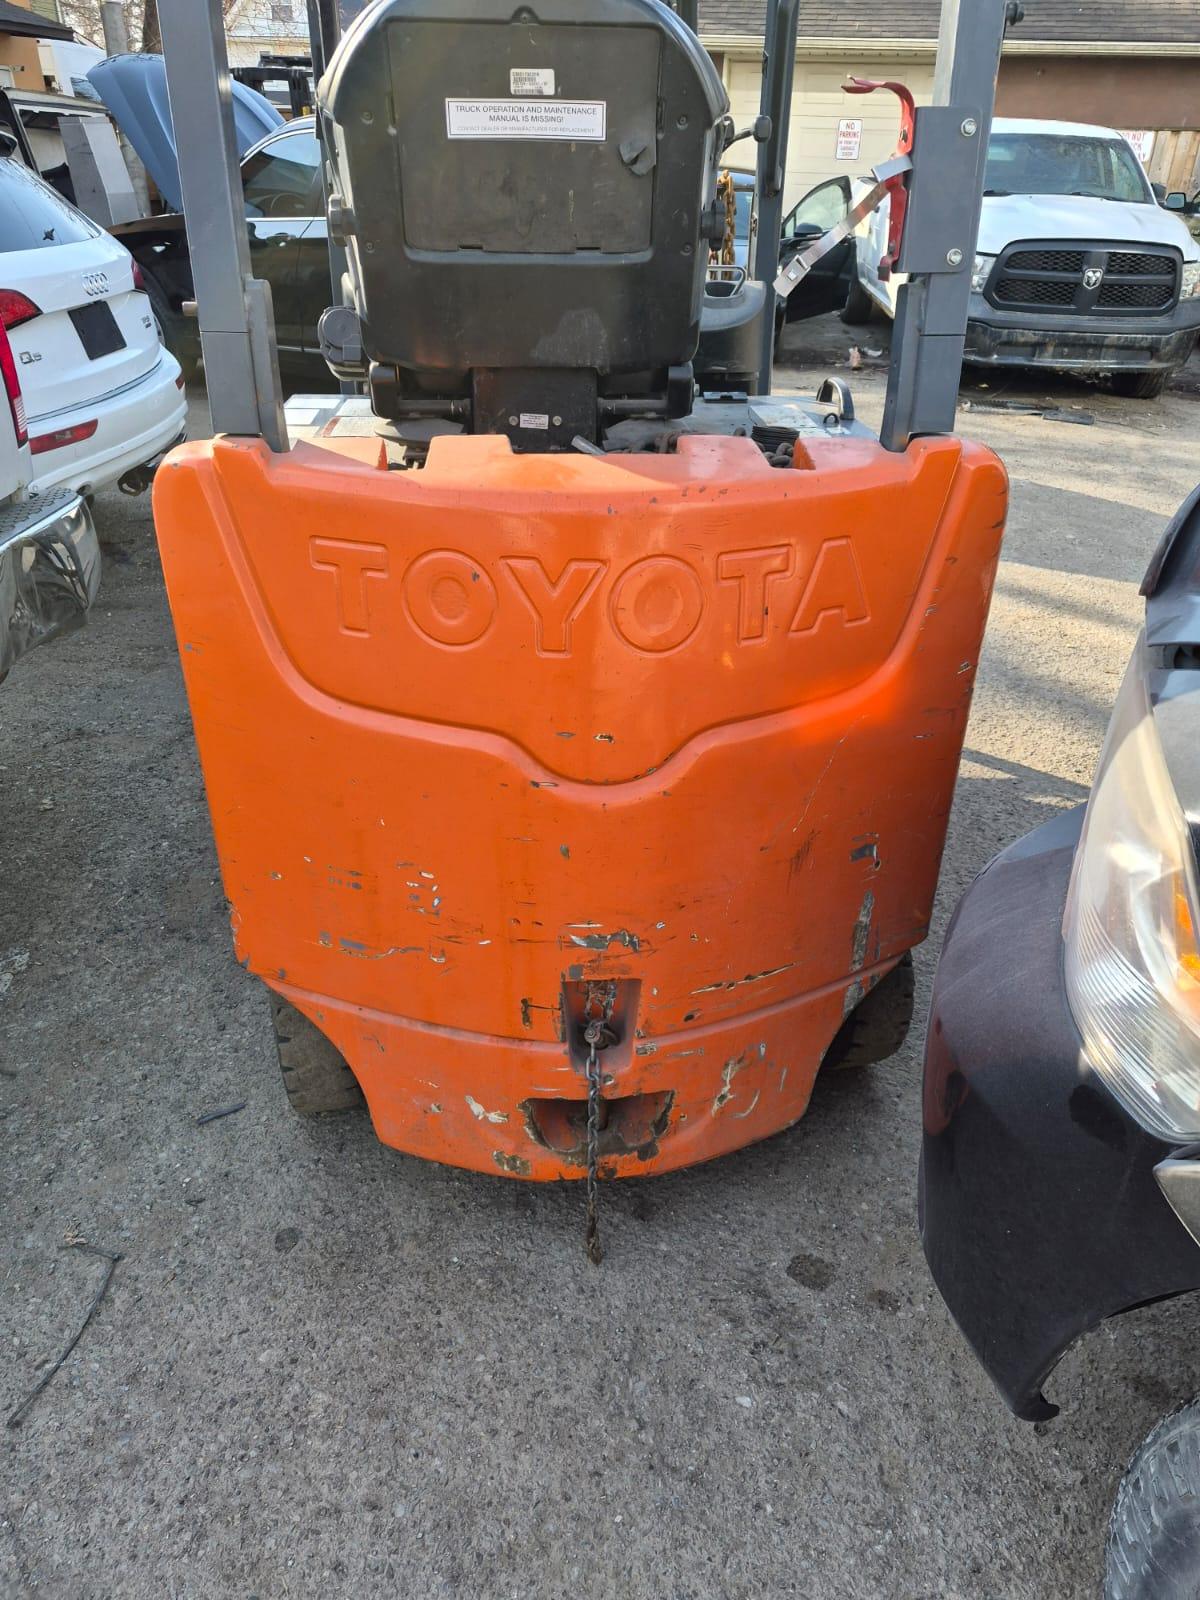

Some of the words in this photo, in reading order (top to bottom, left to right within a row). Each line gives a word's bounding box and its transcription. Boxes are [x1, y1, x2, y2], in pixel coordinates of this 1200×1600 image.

[482, 105, 525, 113] OPERATION
[543, 106, 597, 115] MAINTENANCE
[531, 115, 564, 123] MISSING!
[19, 351, 42, 364] Q5
[309, 535, 871, 659] TOYOTA
